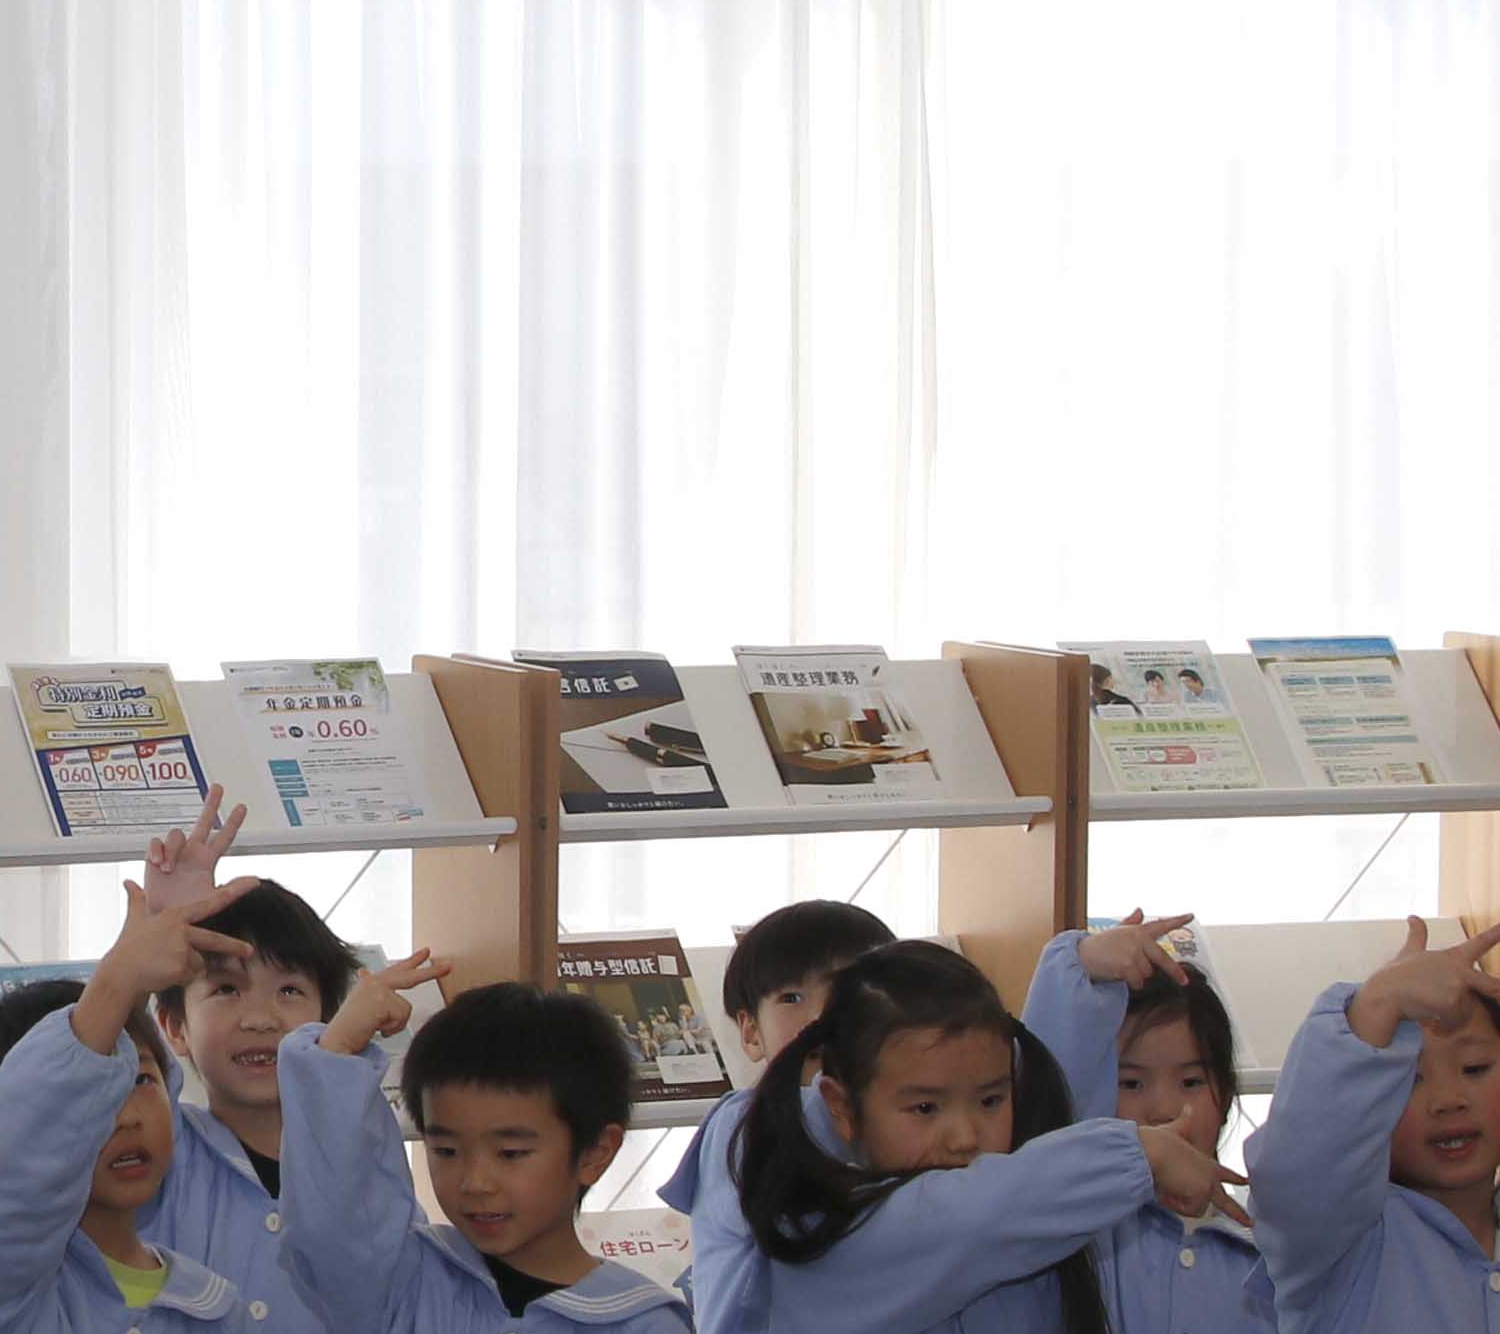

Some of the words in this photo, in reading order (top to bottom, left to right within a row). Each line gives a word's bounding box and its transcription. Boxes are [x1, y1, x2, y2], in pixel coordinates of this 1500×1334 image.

[759, 670, 859, 688] 遺産整理業務
[86, 703, 153, 719] 定期預金
[266, 694, 362, 711] 年金定期預金
[317, 719, 367, 739] 0.60
[558, 956, 658, 978] 年贈与型信託
